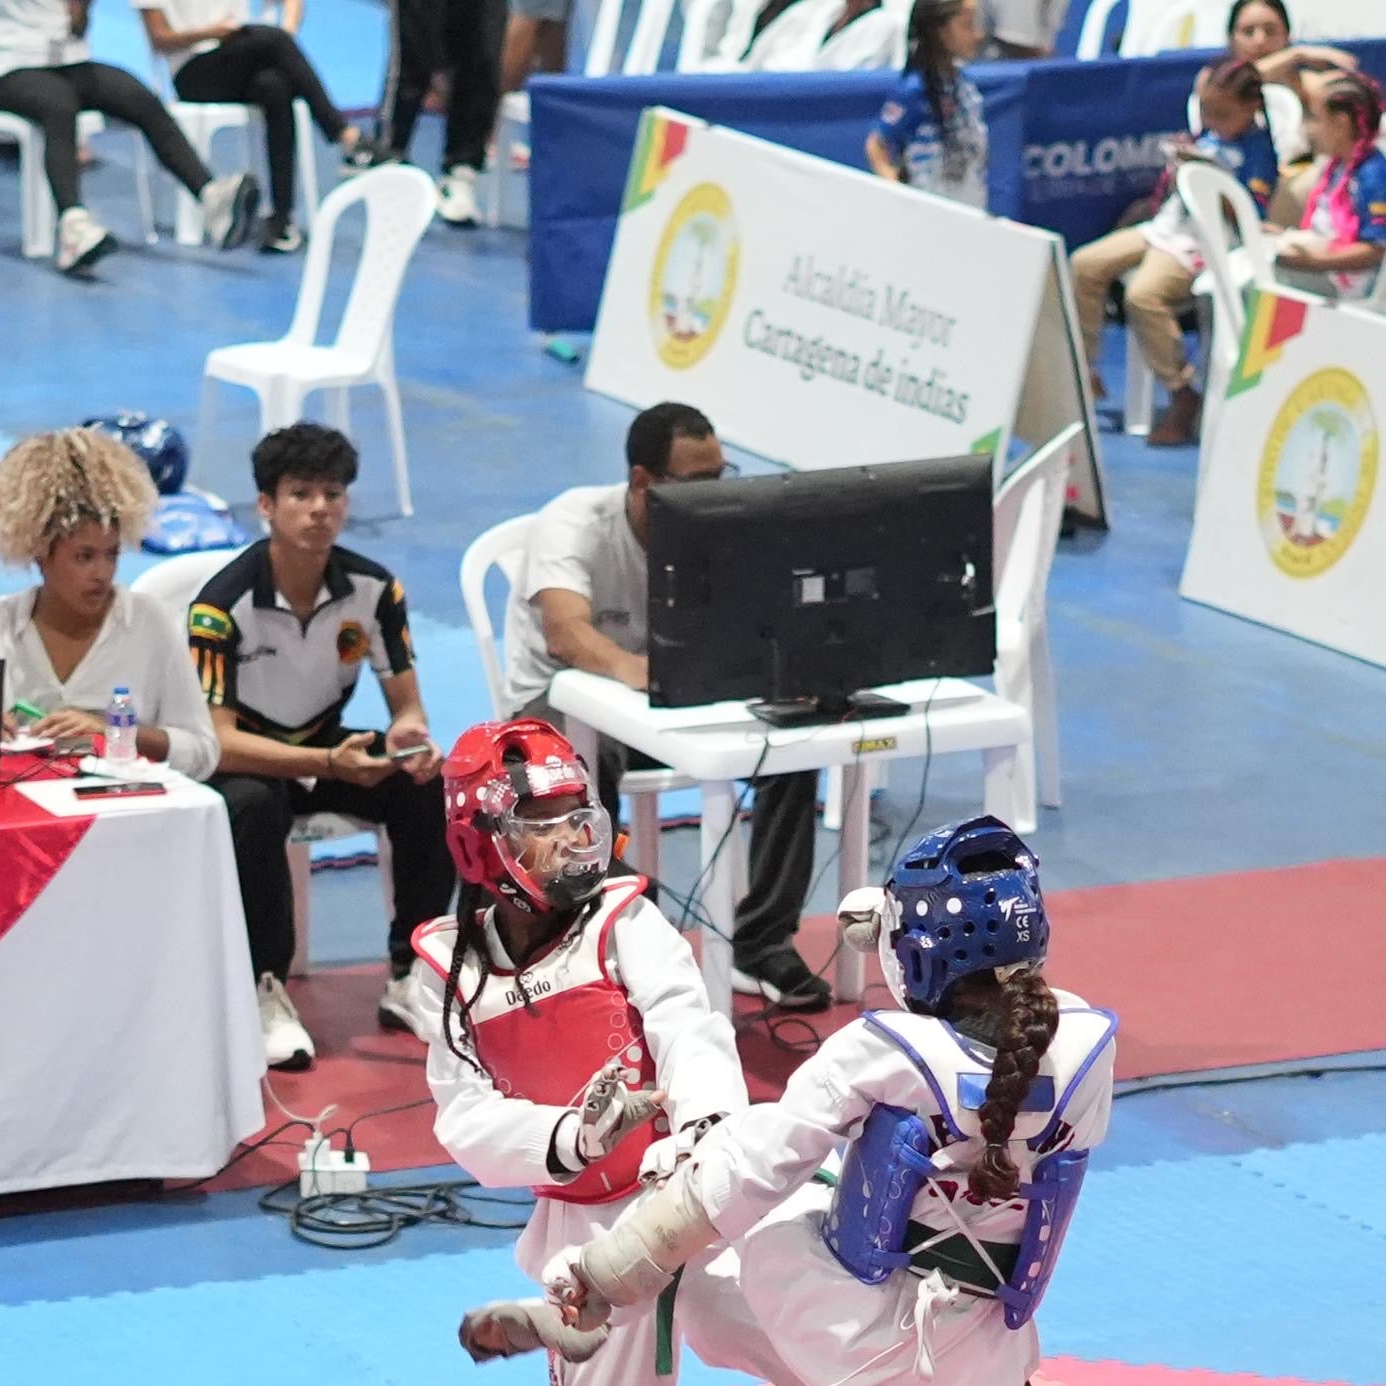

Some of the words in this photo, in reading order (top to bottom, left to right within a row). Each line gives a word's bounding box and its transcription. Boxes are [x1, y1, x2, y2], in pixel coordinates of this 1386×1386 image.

[1022, 131, 1168, 179] COLOM
[782, 254, 875, 320] Alcaldía
[877, 284, 956, 349] Mayor
[743, 308, 861, 382] Cartagena
[864, 348, 893, 397] de
[893, 357, 969, 424] indias
[1016, 930, 1030, 943] XS
[505, 980, 551, 1006] Daedo
